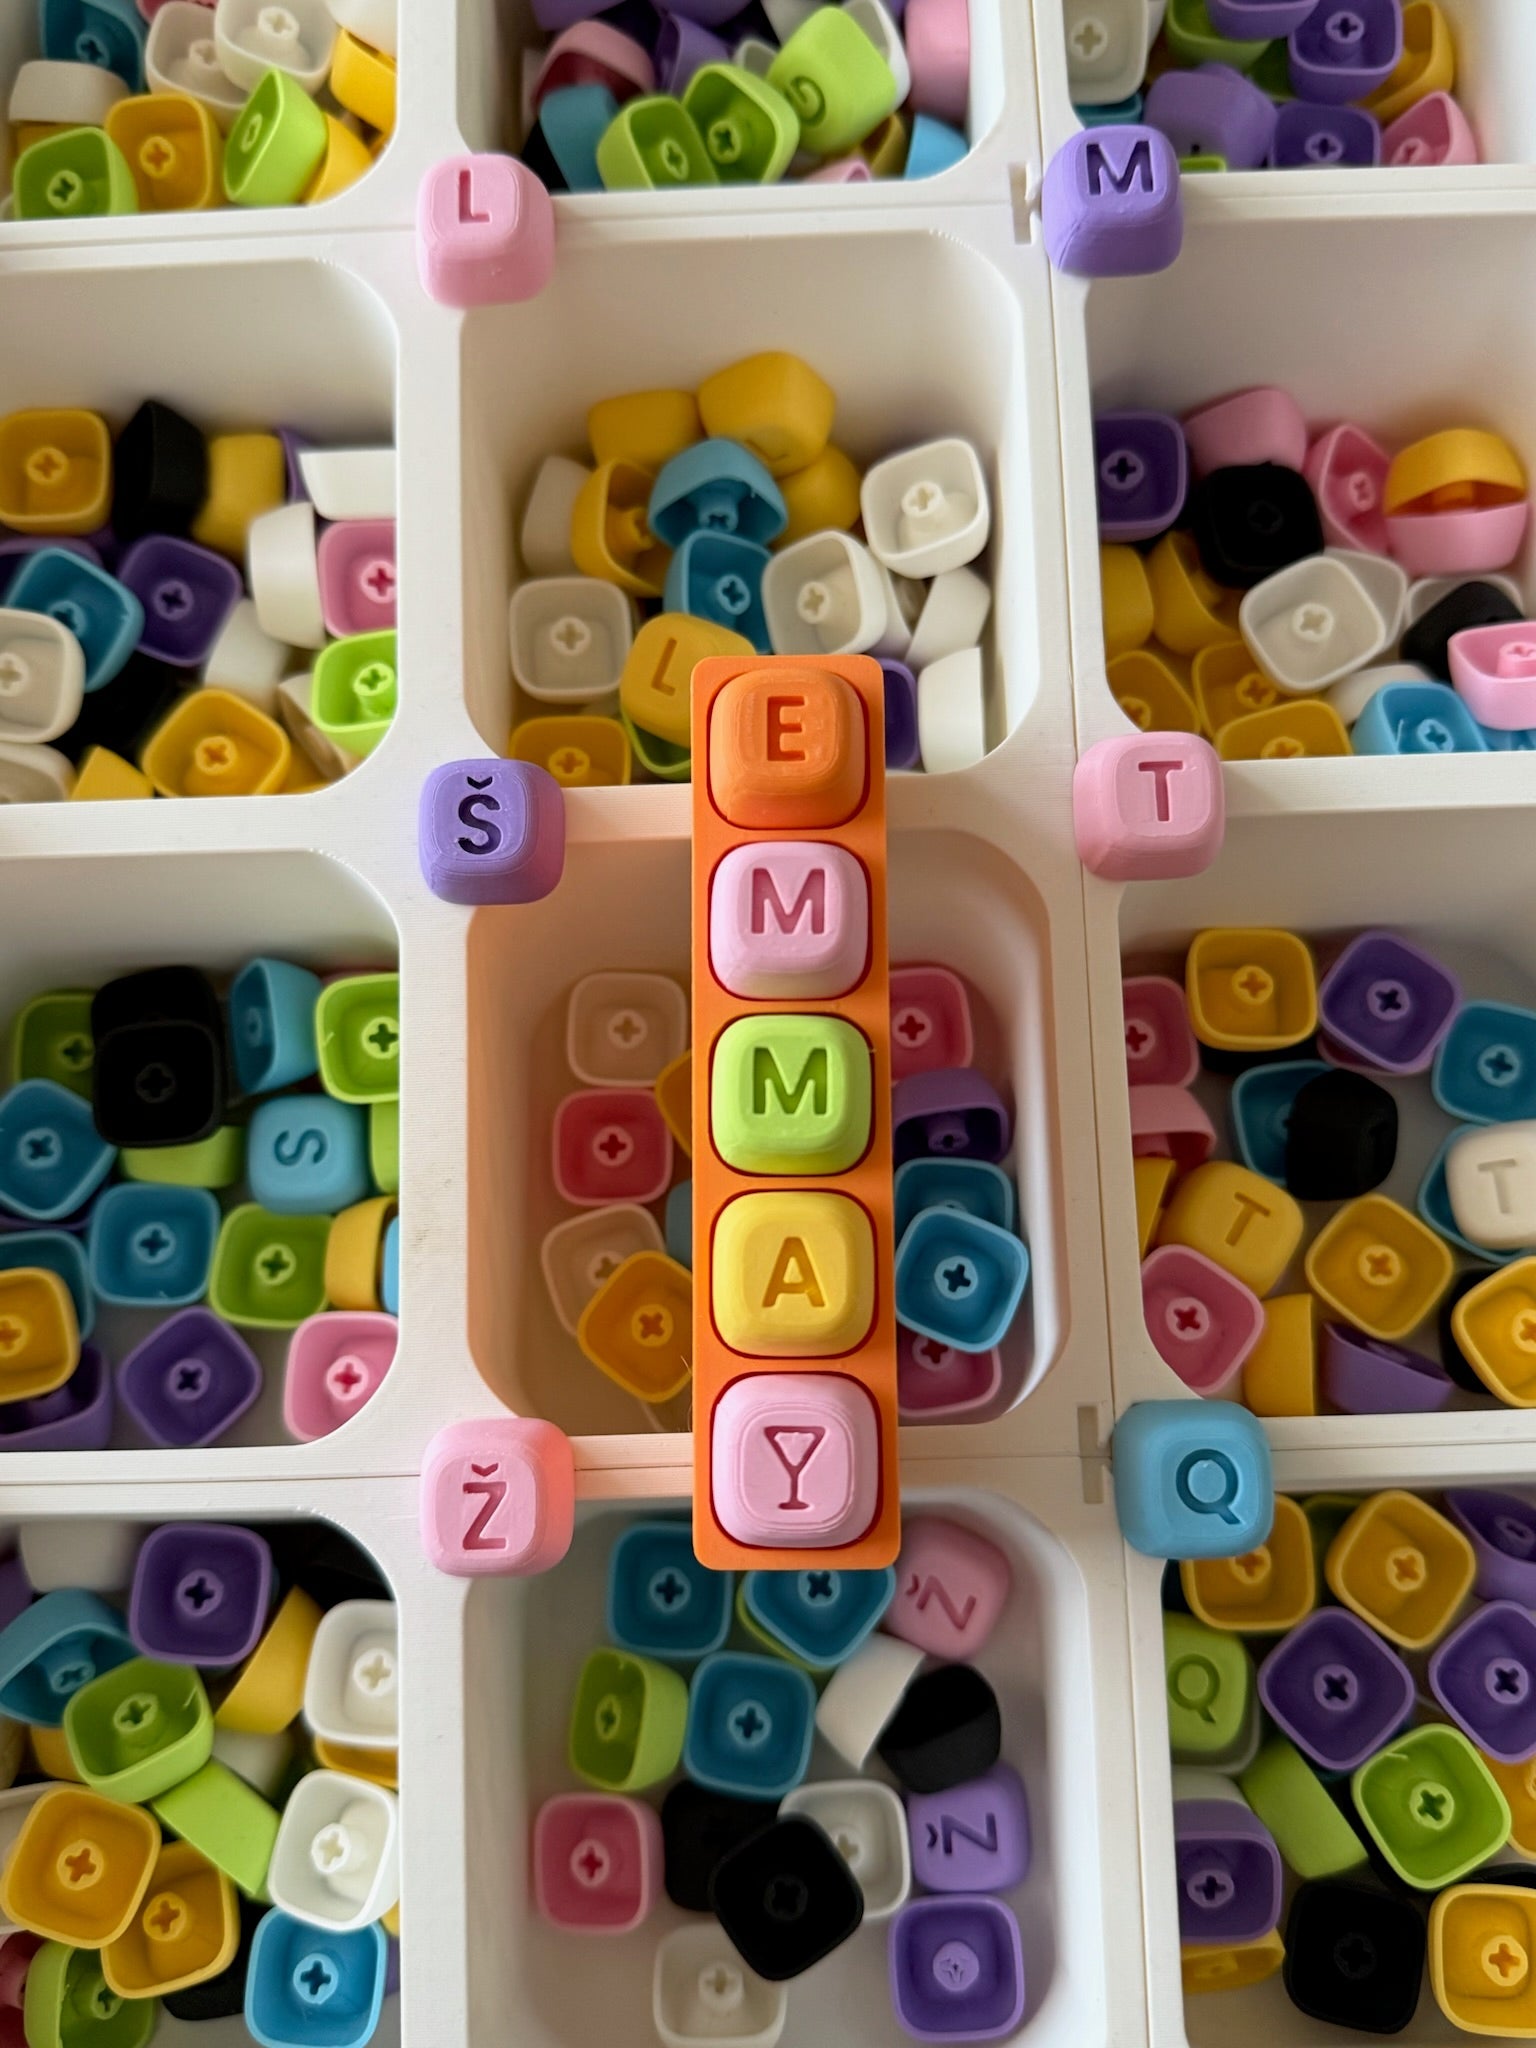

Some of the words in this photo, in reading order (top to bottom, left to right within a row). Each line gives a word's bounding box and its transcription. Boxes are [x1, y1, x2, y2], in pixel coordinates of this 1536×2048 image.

[458, 170, 490, 224] L
[1086, 140, 1153, 195] M
[651, 637, 677, 696] L
[457, 776, 502, 855] Š
[1138, 760, 1184, 822] T
[273, 1128, 328, 1166] S
[1477, 1158, 1518, 1214] T
[1224, 1191, 1271, 1247] T
[462, 1462, 507, 1551] Ž
[1175, 1448, 1241, 1525] Q
[1166, 1653, 1220, 1724] Q
